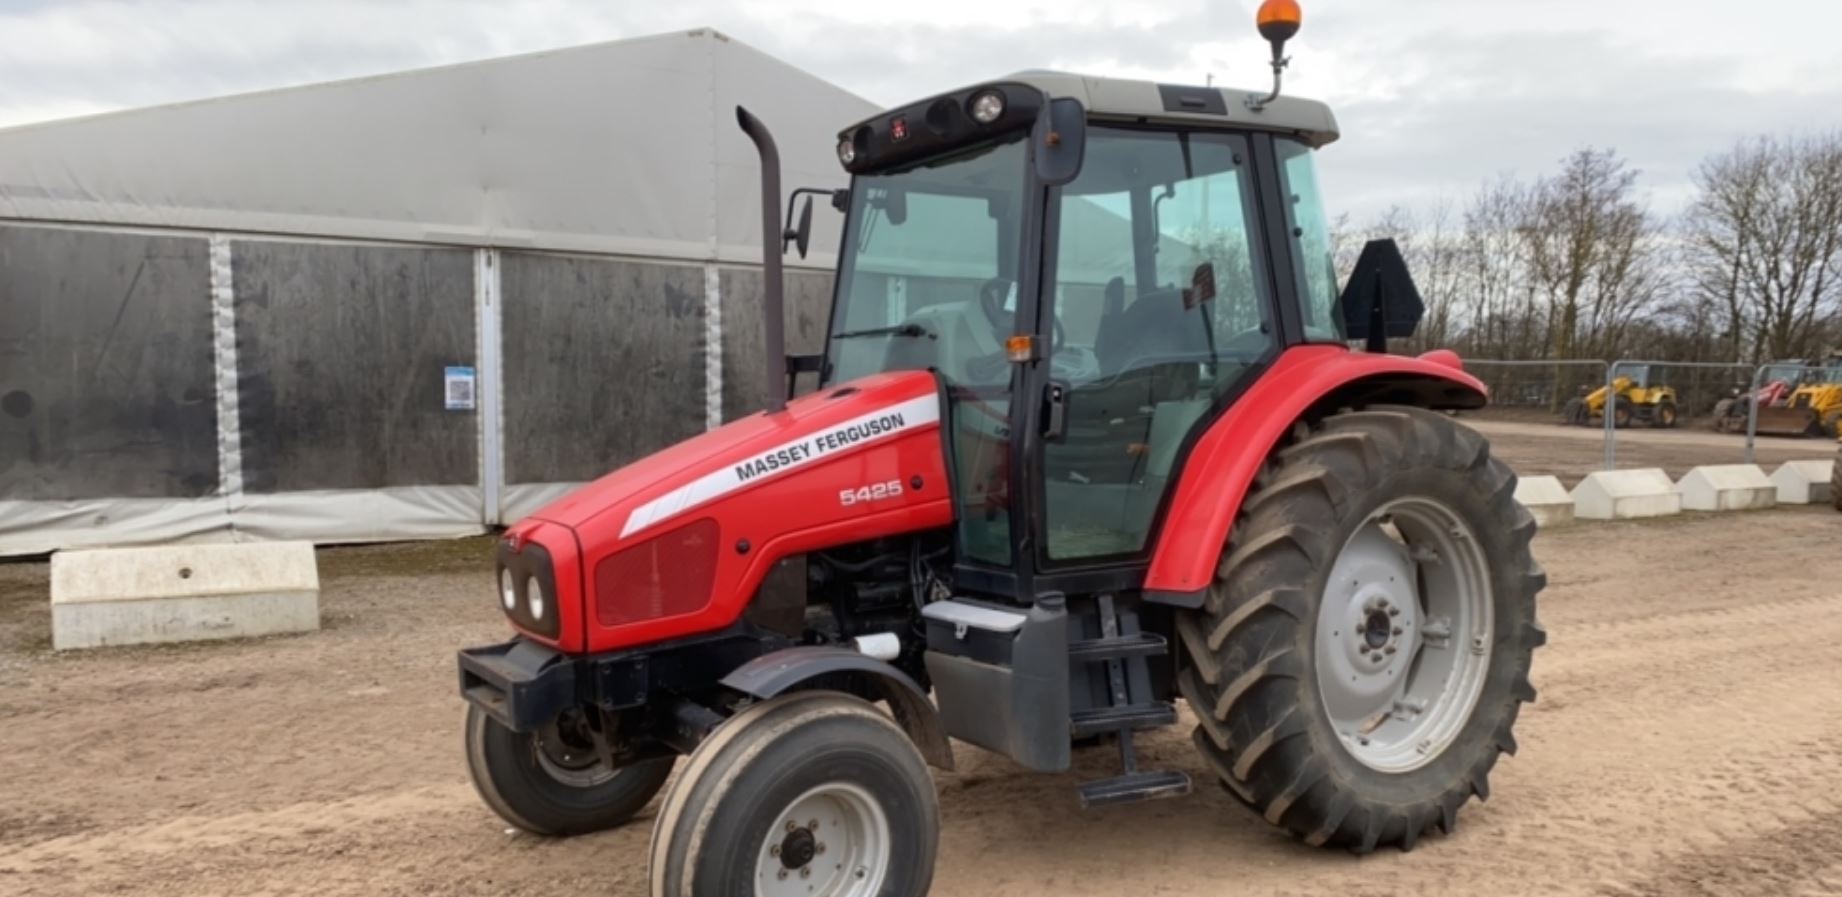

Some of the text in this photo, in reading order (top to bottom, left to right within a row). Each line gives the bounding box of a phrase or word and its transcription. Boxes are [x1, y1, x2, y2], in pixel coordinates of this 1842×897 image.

[735, 413, 905, 481] MASSEY FERGUSON
[839, 480, 903, 506] 5425
